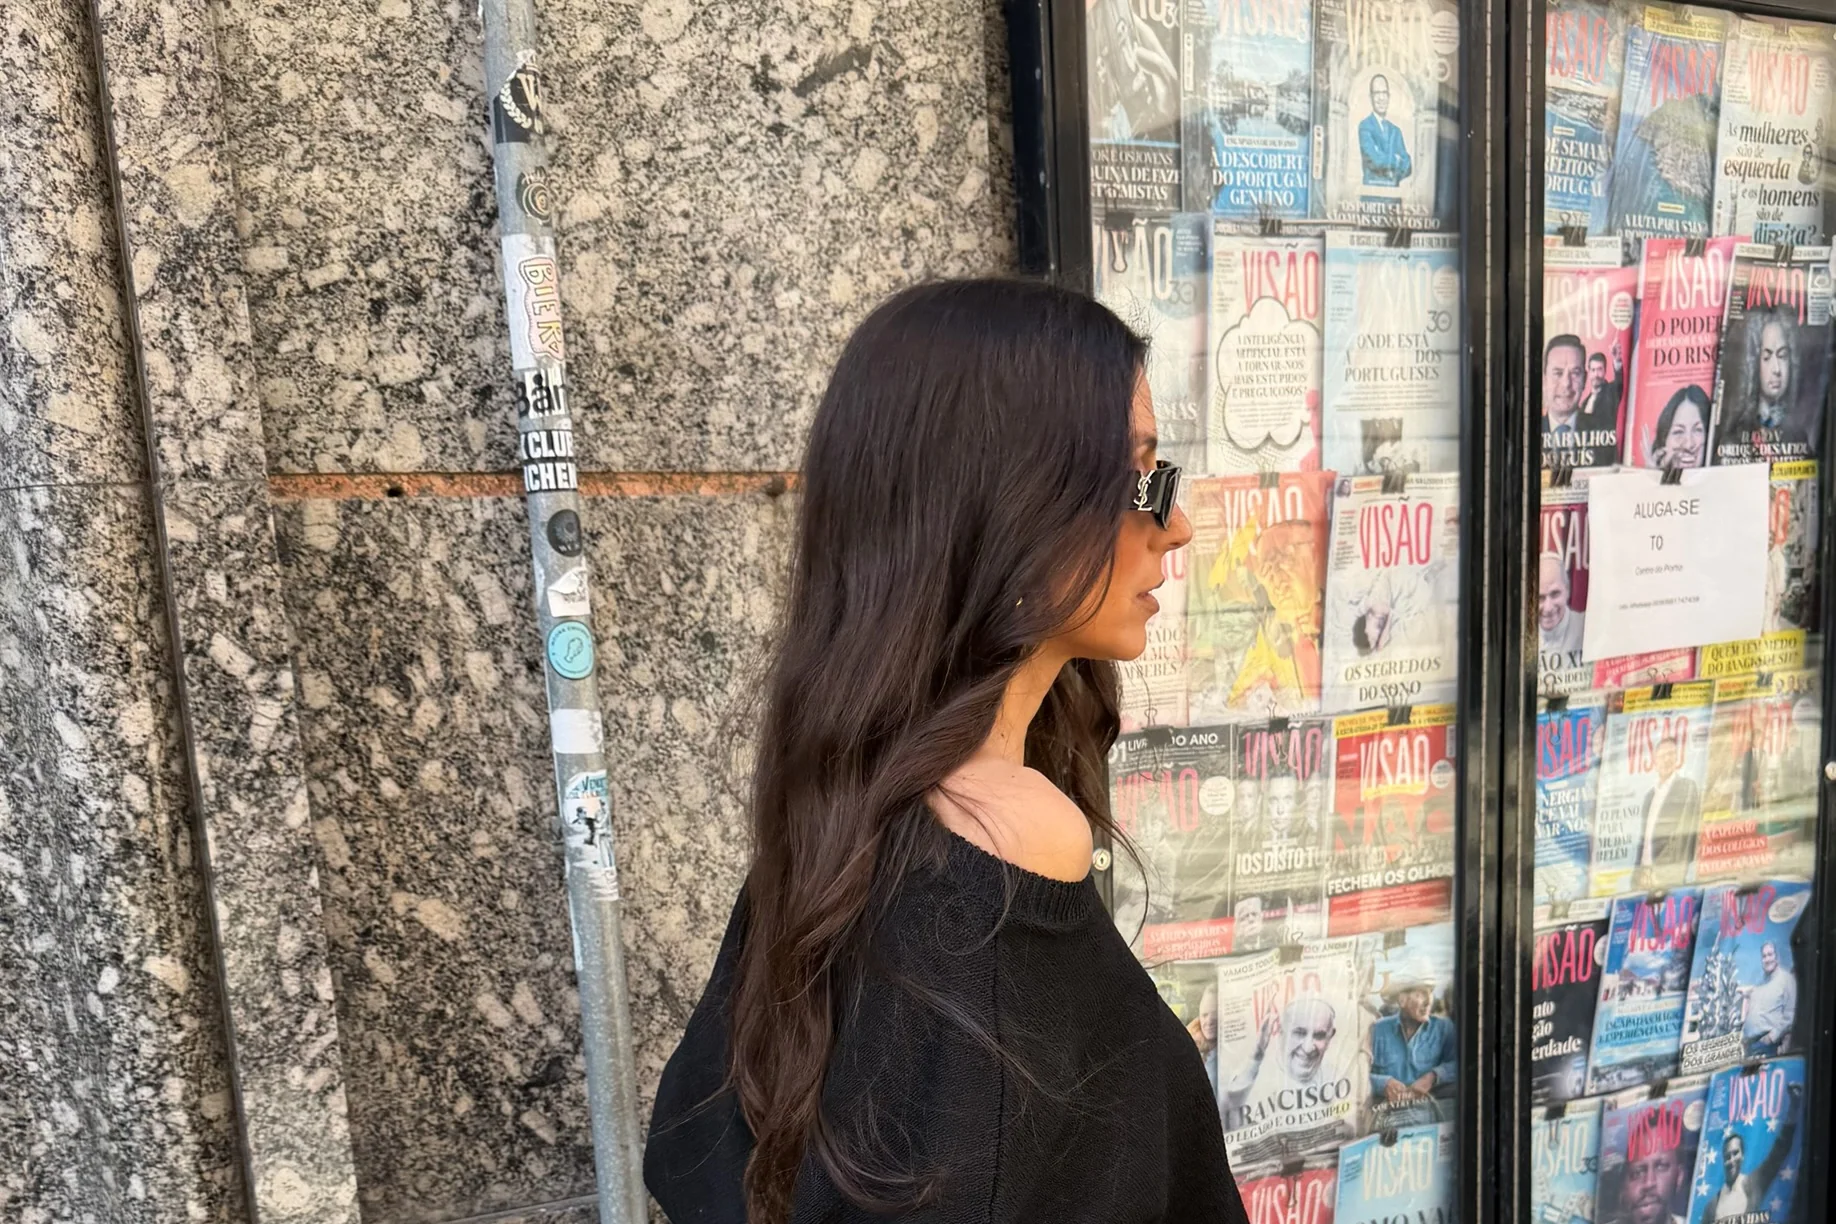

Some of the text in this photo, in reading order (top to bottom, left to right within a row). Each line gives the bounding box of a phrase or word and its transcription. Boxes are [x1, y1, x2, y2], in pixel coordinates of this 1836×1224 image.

[1546, 10, 1609, 82] ISÃO
[1740, 121, 1809, 145] mulheres
[1222, 151, 1303, 170] DESCOBERT
[1562, 139, 1611, 161] SEMAN
[1131, 166, 1151, 182] DE
[1152, 168, 1182, 184] FAZE
[1212, 169, 1233, 186] DO
[1723, 157, 1791, 183] esquerda
[1758, 183, 1821, 207] homens
[1424, 217, 1441, 229] DO
[1241, 242, 1320, 320] VISÃO
[523, 264, 562, 347] BIER
[1426, 310, 1453, 333] 30
[1654, 319, 1666, 338] O
[1357, 330, 1430, 349] ONDE ESTÁ
[1415, 349, 1443, 364] DOS
[1654, 347, 1681, 367] DO
[1344, 366, 1441, 383] PORTUGUESES
[1542, 430, 1617, 449] RABALHOS
[1633, 499, 1701, 519] ALUGA-SE
[1360, 496, 1433, 569] VISÃO
[1344, 656, 1442, 682] OS SEGREDOS
[1707, 662, 1724, 676] DO
[1359, 686, 1378, 702] DO
[1189, 732, 1219, 746] ANO
[1628, 709, 1689, 776] VISÃO
[1360, 729, 1430, 801] VISÃO
[1328, 872, 1383, 896] FECHEM
[1384, 868, 1406, 885] OS
[1532, 923, 1595, 991] VISÃO
[1223, 961, 1254, 977] VAMOS
[1728, 1062, 1785, 1122] VISÃO
[1225, 1133, 1234, 1145] O
[1285, 1114, 1296, 1125] O
[1298, 1102, 1350, 1125] EXEMPLO
[1362, 1132, 1433, 1201] VISÃO
